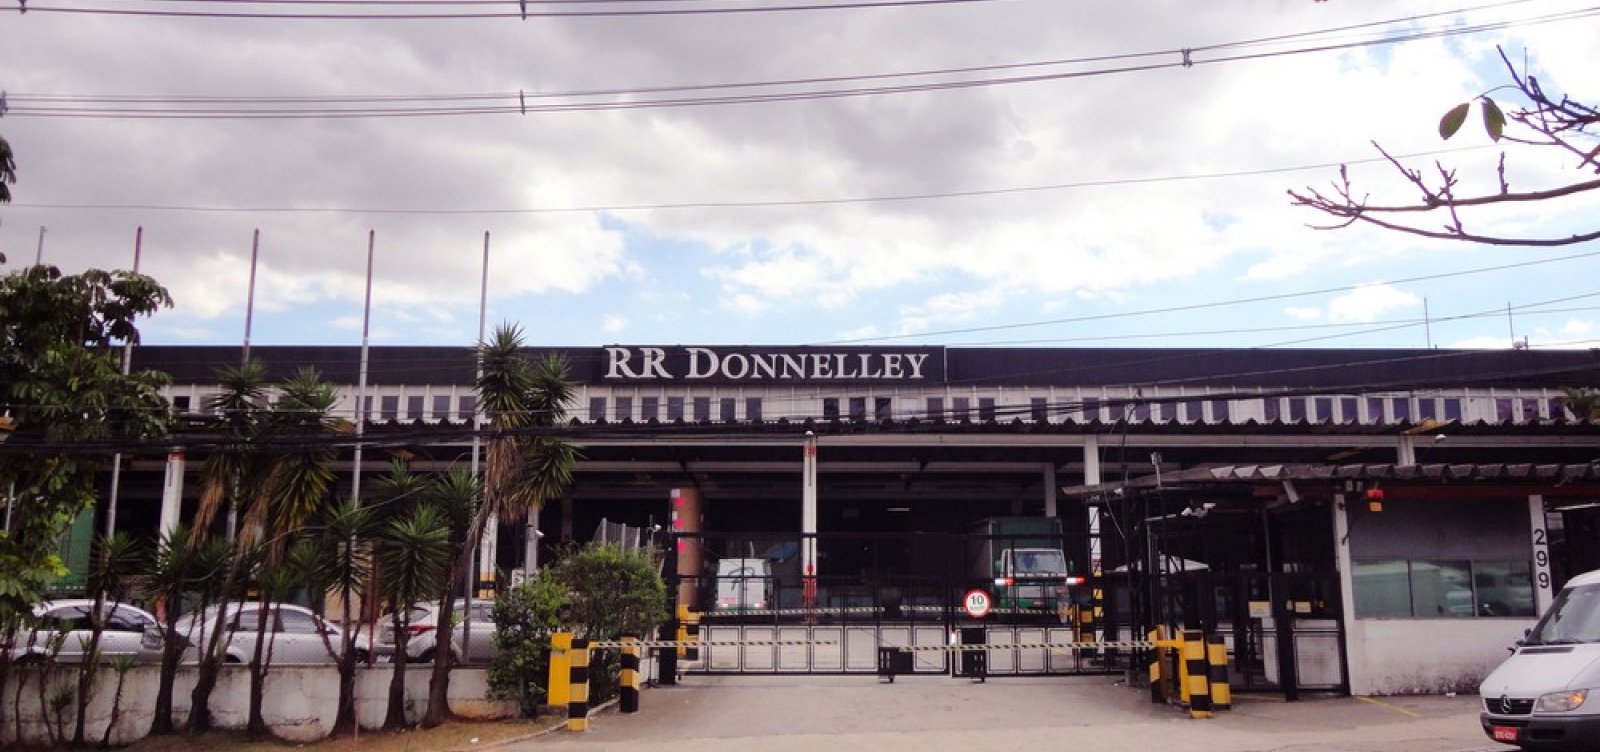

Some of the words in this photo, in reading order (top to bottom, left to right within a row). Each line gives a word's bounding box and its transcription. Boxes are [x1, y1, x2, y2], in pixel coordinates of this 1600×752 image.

[604, 346, 674, 380] RR
[685, 346, 929, 380] DONNELLEY
[1534, 528, 1549, 589] 299
[970, 595, 985, 605] 10
